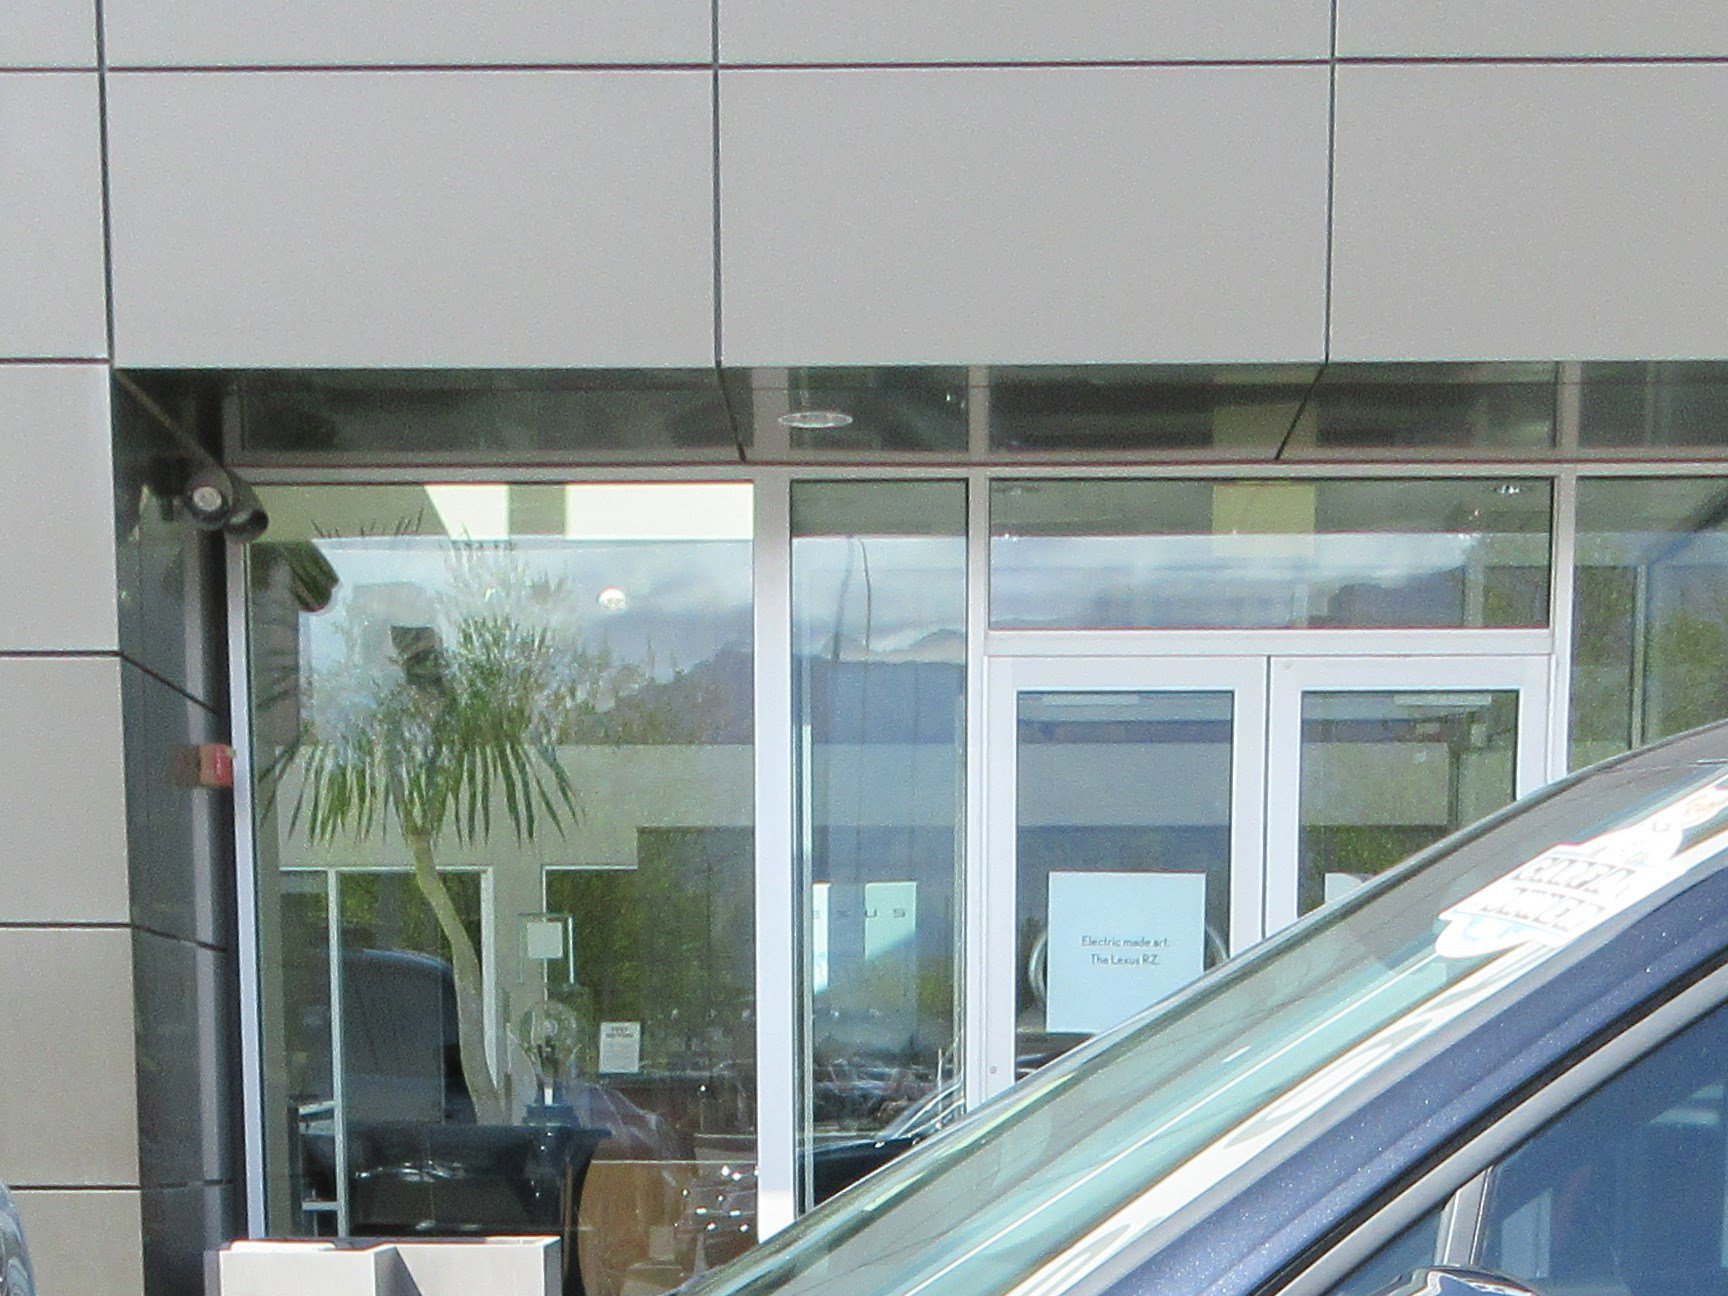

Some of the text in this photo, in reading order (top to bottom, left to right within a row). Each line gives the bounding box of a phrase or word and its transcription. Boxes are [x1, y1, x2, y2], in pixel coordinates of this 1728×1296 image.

[1081, 935, 1121, 947] Electric
[1123, 936, 1151, 947] made
[1091, 953, 1109, 965] The
[1110, 953, 1140, 966] Lexus
